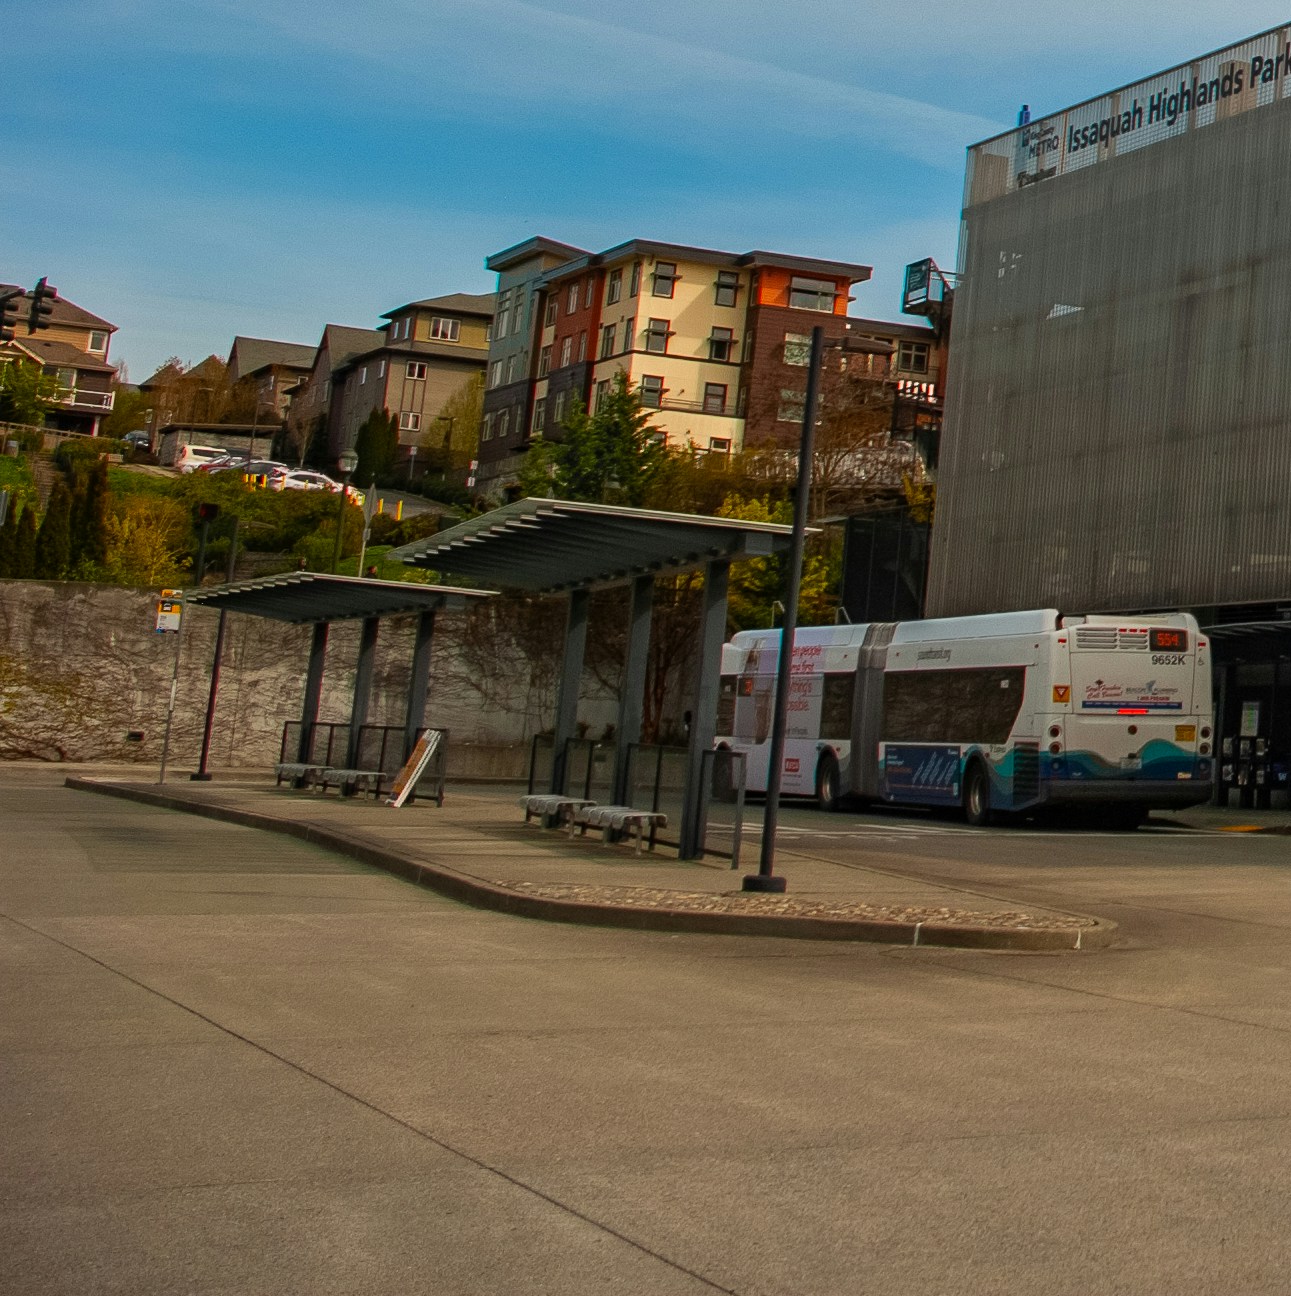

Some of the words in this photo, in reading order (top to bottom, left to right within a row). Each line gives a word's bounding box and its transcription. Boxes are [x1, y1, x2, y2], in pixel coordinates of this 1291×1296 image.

[1067, 98, 1143, 154] Issaquah
[1148, 63, 1244, 126] Highlands
[1157, 632, 1180, 646] 554
[1151, 655, 1186, 665] 9652K
